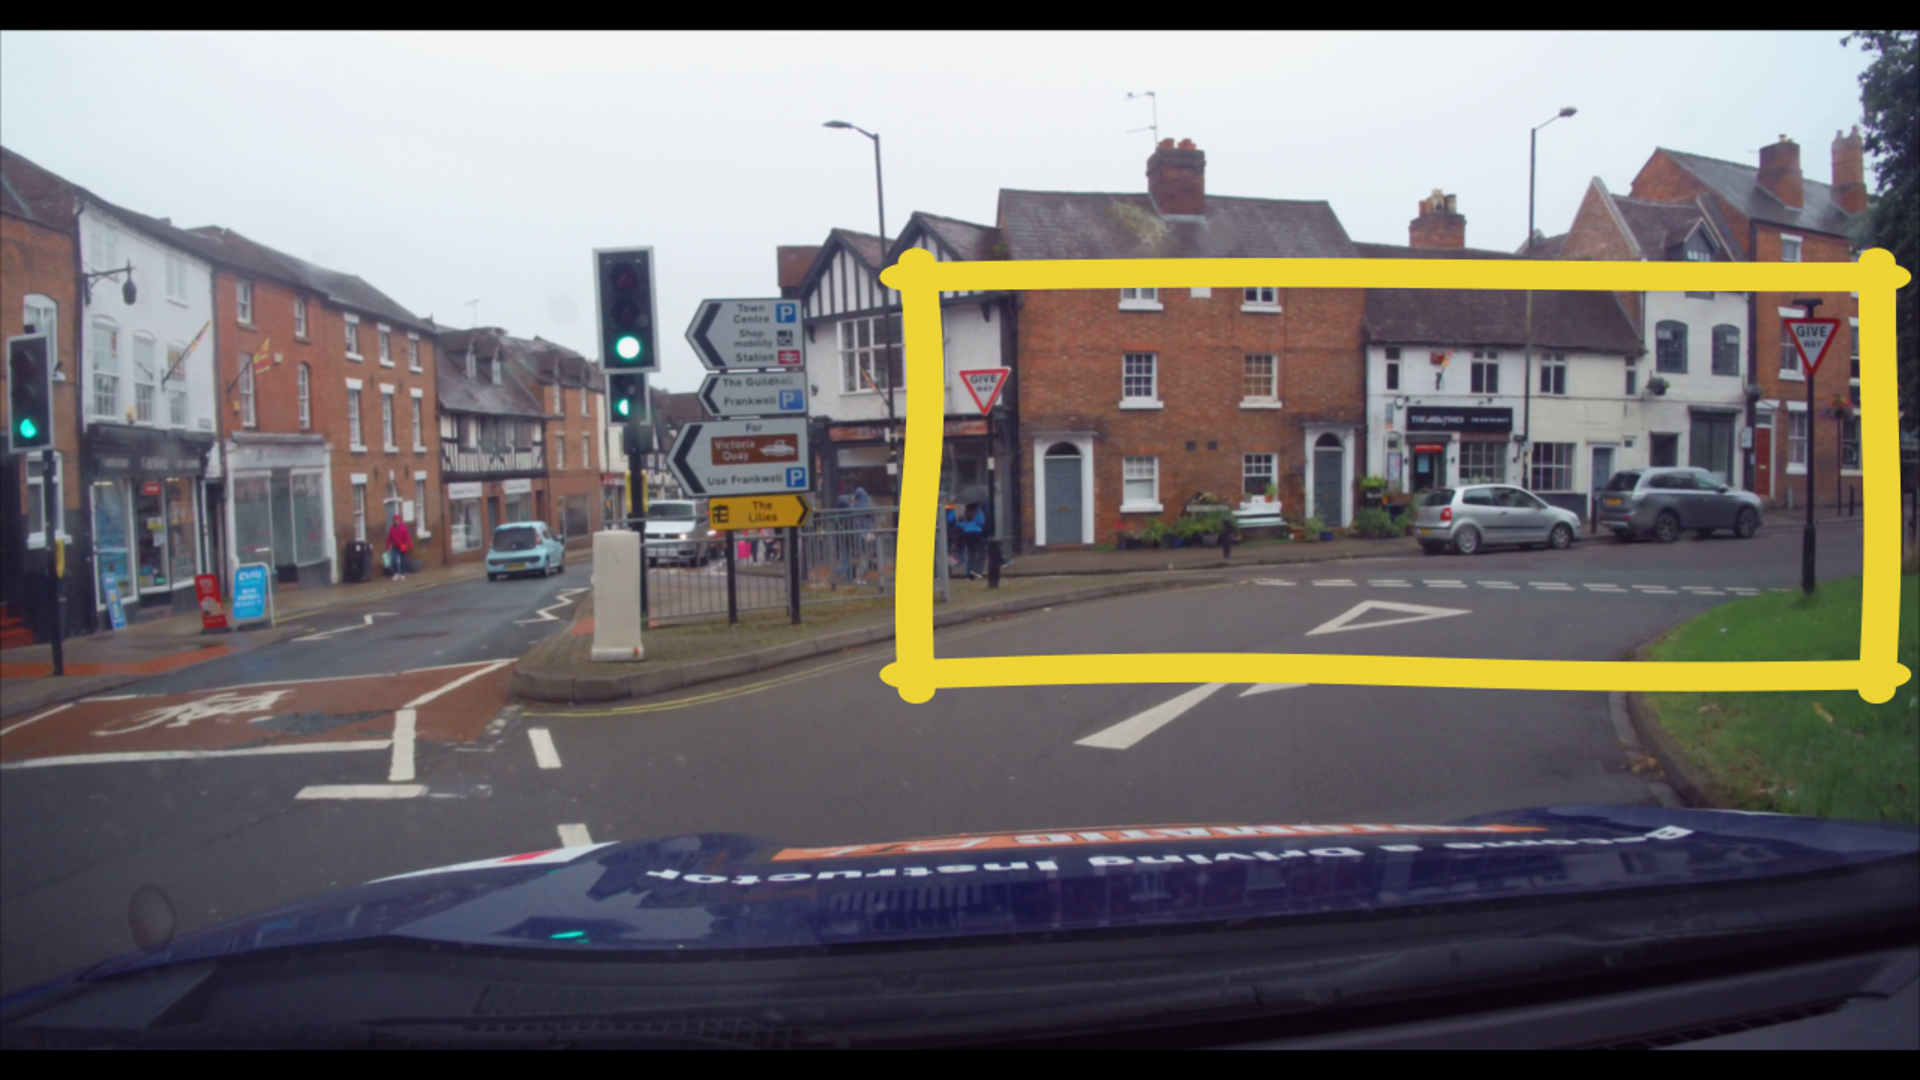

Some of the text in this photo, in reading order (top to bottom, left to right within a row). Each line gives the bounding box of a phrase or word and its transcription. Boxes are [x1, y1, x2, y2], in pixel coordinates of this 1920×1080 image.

[736, 304, 765, 312] Town
[733, 315, 770, 324] Centre
[739, 330, 767, 339] Shop-
[1796, 325, 1827, 337] GIVE
[734, 340, 773, 349] mobility
[735, 353, 775, 363] Station
[723, 376, 794, 387] The Guildhall
[970, 374, 997, 384] GIVE
[724, 396, 776, 406] Frankwell
[746, 423, 762, 433] For
[714, 440, 756, 450] Victoria
[722, 452, 749, 462] Quay
[707, 477, 728, 486] Use
[731, 473, 783, 485] Frankwell
[752, 501, 773, 510] The
[748, 513, 778, 522] Lilies
[646, 825, 1695, 885] Become a Driving Instructor
